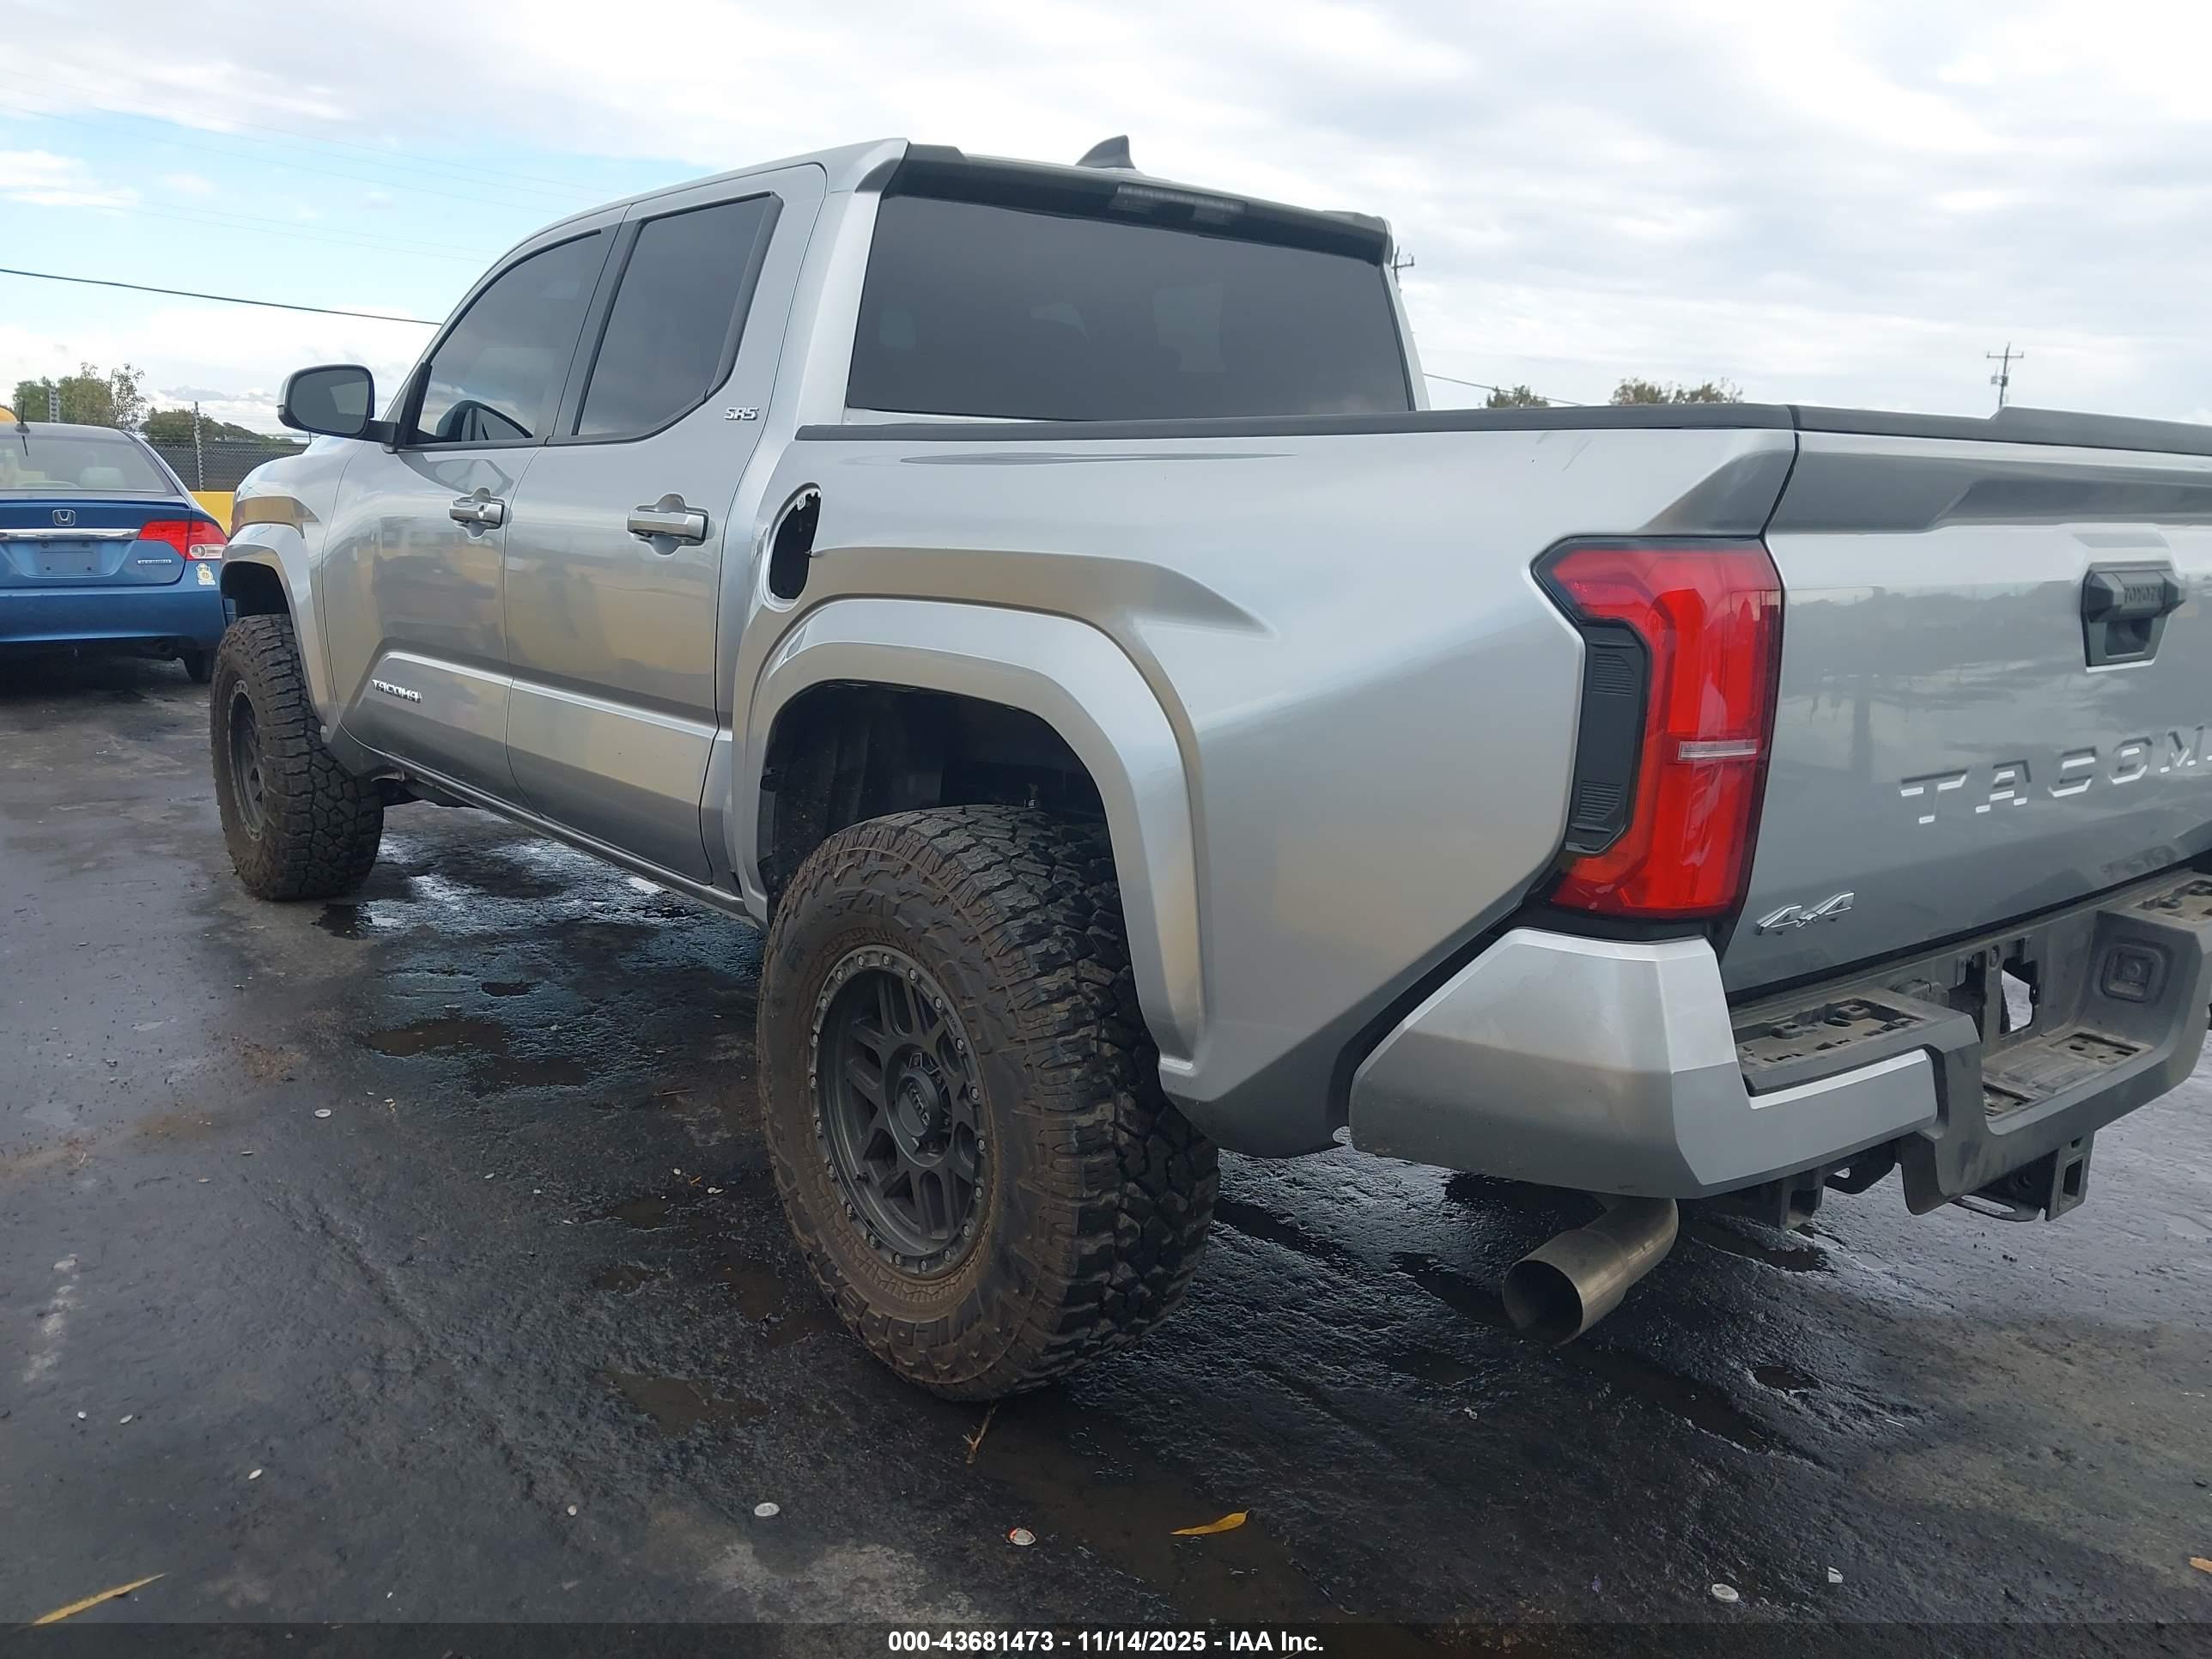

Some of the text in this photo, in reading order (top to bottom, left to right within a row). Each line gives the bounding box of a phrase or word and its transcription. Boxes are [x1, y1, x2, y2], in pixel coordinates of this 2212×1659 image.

[724, 406, 759, 420] SR5
[372, 678, 423, 702] TACOMA
[1899, 726, 2212, 824] TACOM
